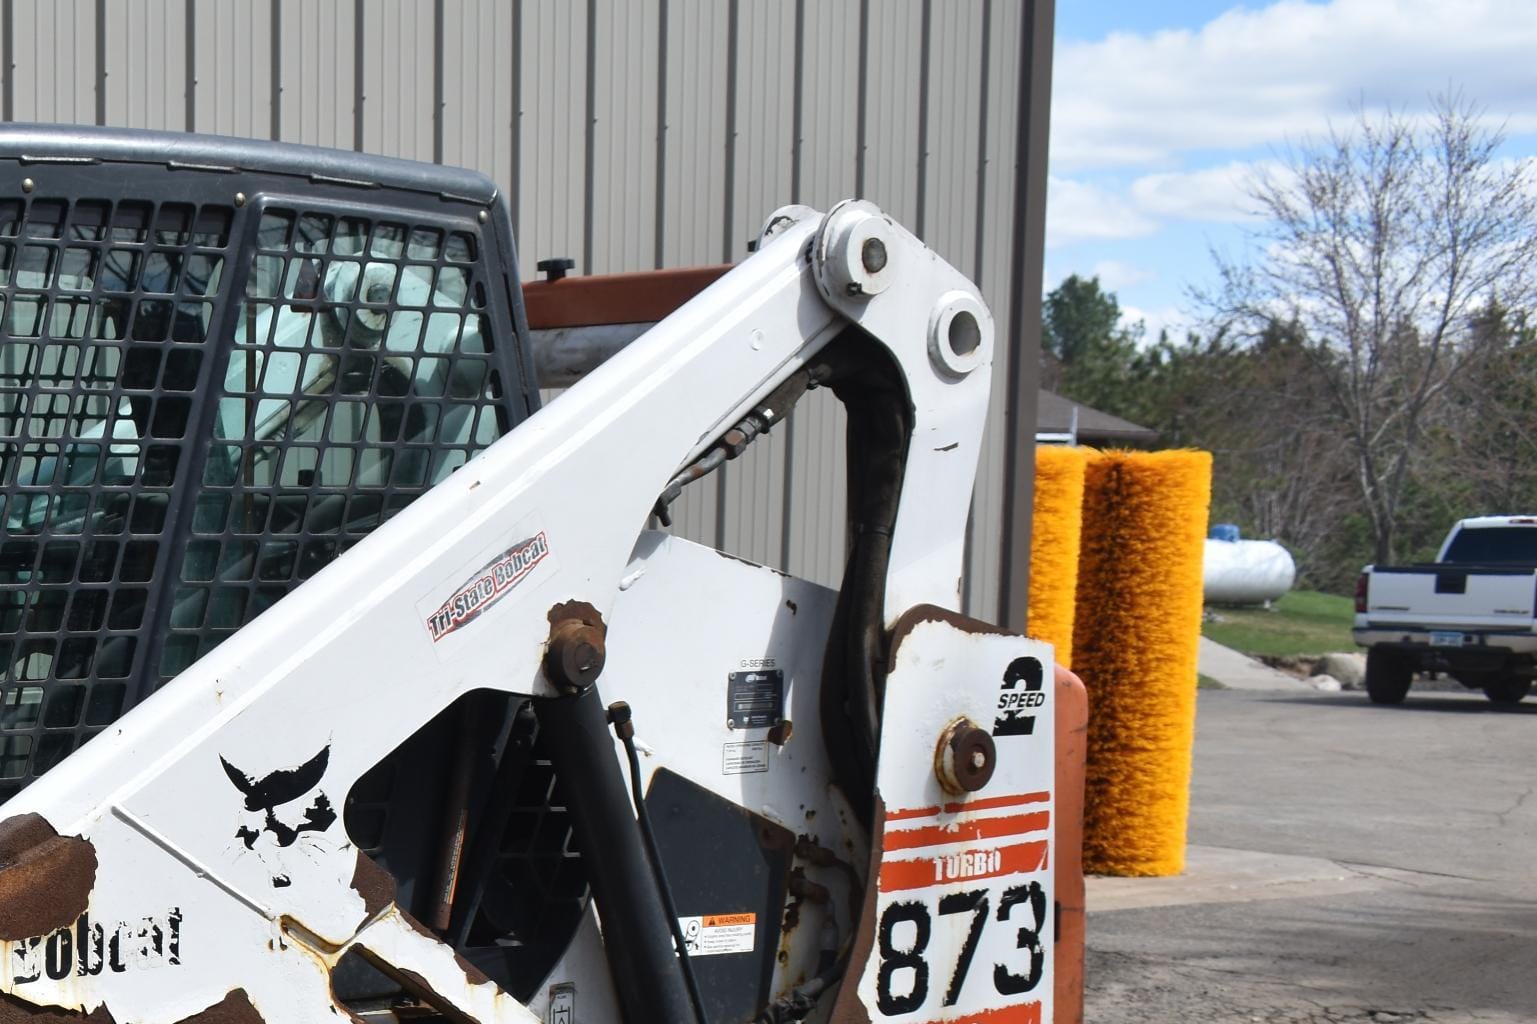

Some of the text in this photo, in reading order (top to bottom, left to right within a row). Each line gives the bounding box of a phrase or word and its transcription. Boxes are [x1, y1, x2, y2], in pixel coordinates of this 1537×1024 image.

[428, 535, 546, 638] Tri-State Bobcat
[740, 658, 776, 668] G-SERIES
[992, 656, 1043, 736] 2
[997, 692, 1046, 709] SPEED
[932, 850, 1002, 881] TURBO
[718, 915, 751, 925] WARNING
[876, 880, 1047, 1017] 873
